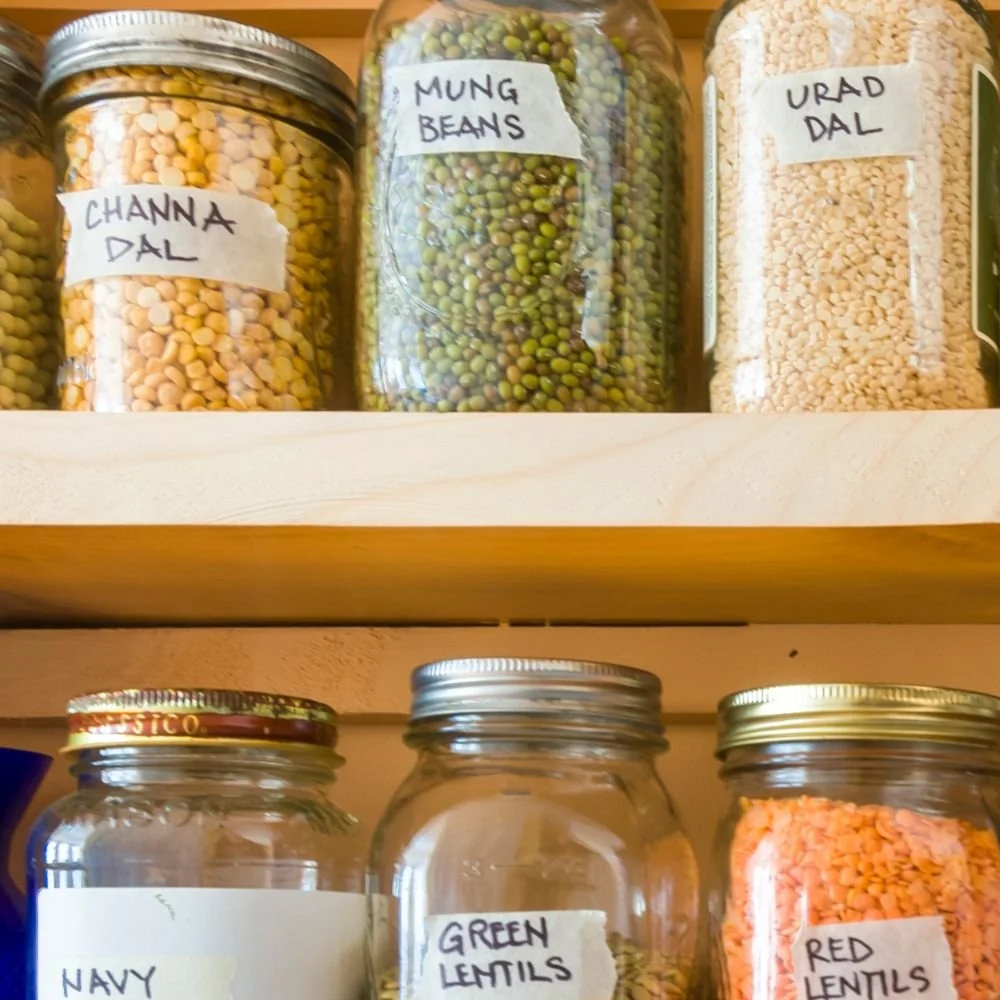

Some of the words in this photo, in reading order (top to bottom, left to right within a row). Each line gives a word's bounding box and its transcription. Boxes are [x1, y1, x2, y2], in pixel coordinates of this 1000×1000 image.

[415, 75, 518, 105] MUNG
[786, 75, 886, 110] URAD
[418, 112, 526, 143] BEANS
[803, 111, 884, 143] DAL
[85, 194, 237, 236] CHANNA
[105, 234, 199, 263] DAL
[439, 916, 549, 954] GREEN
[805, 937, 874, 965] RED
[62, 965, 157, 999] NAVY
[439, 955, 573, 989] LENTILS
